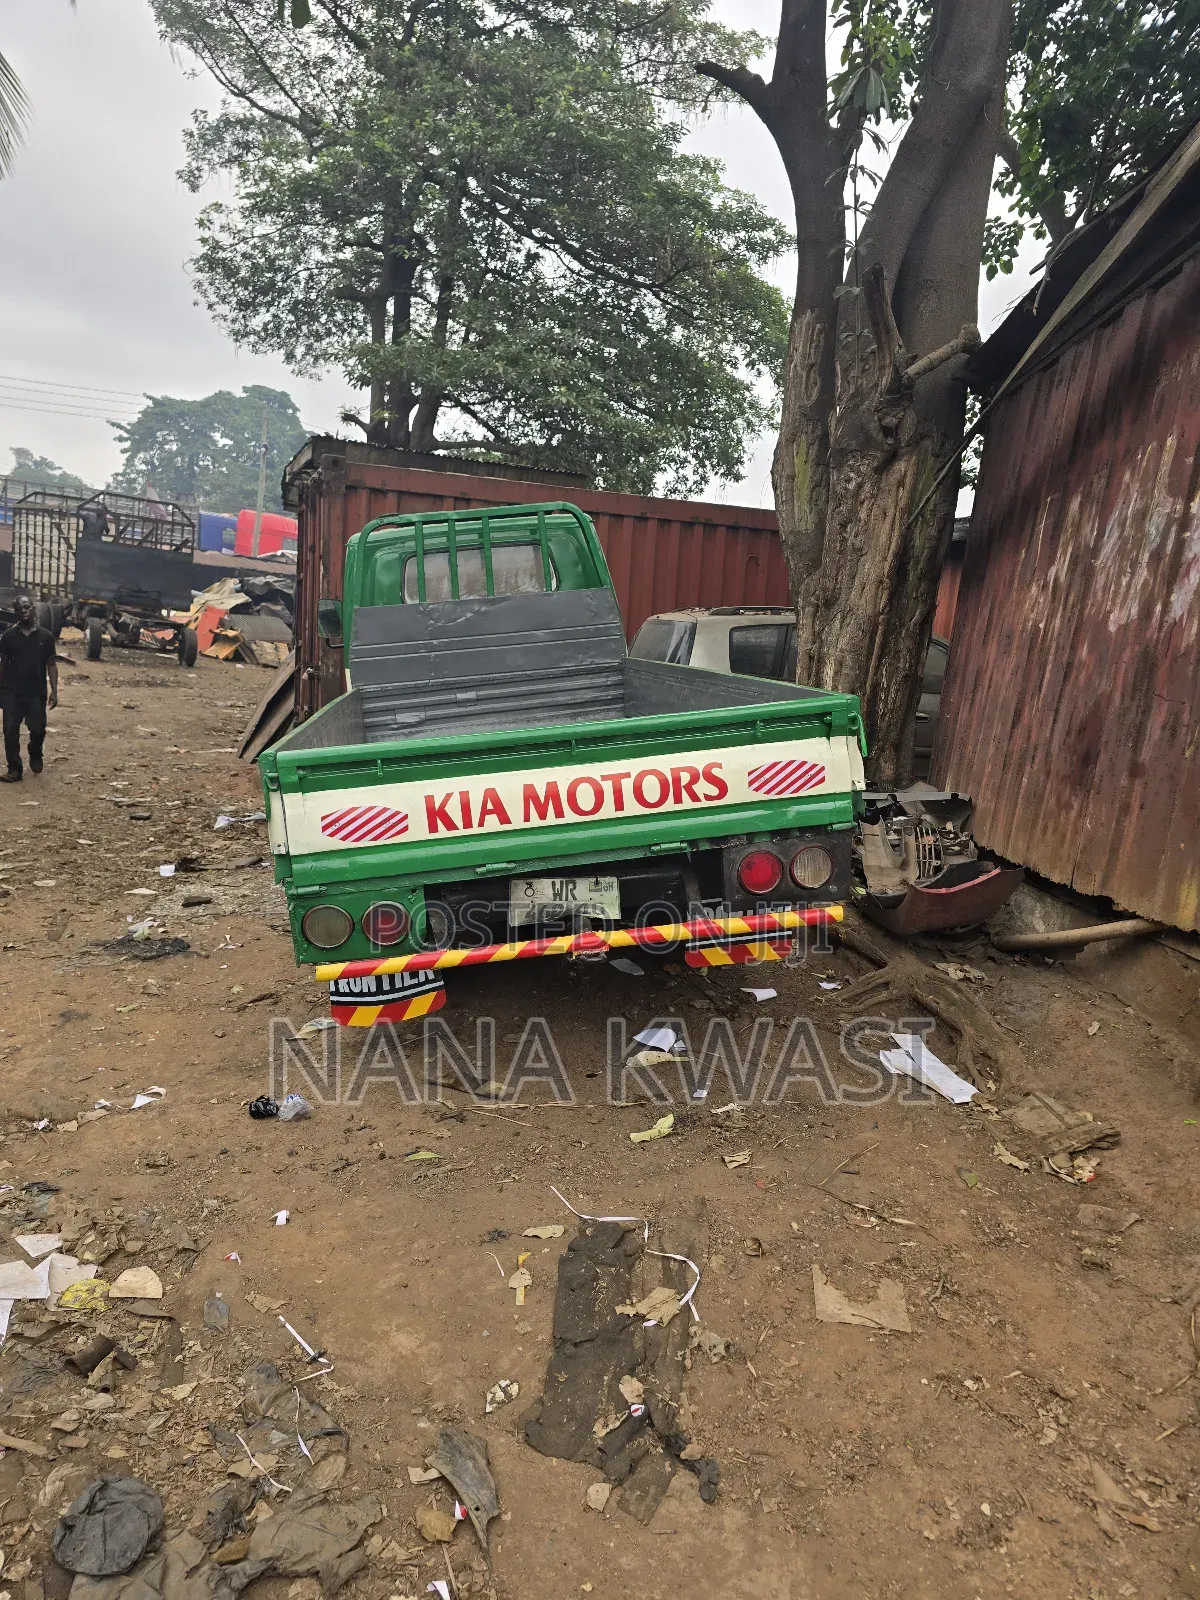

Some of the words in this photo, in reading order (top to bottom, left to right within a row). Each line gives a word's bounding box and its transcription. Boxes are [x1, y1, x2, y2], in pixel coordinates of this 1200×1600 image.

[424, 787, 512, 834] KIA
[522, 761, 729, 822] MOTORS
[551, 880, 577, 901] WR
[602, 882, 614, 893] GH
